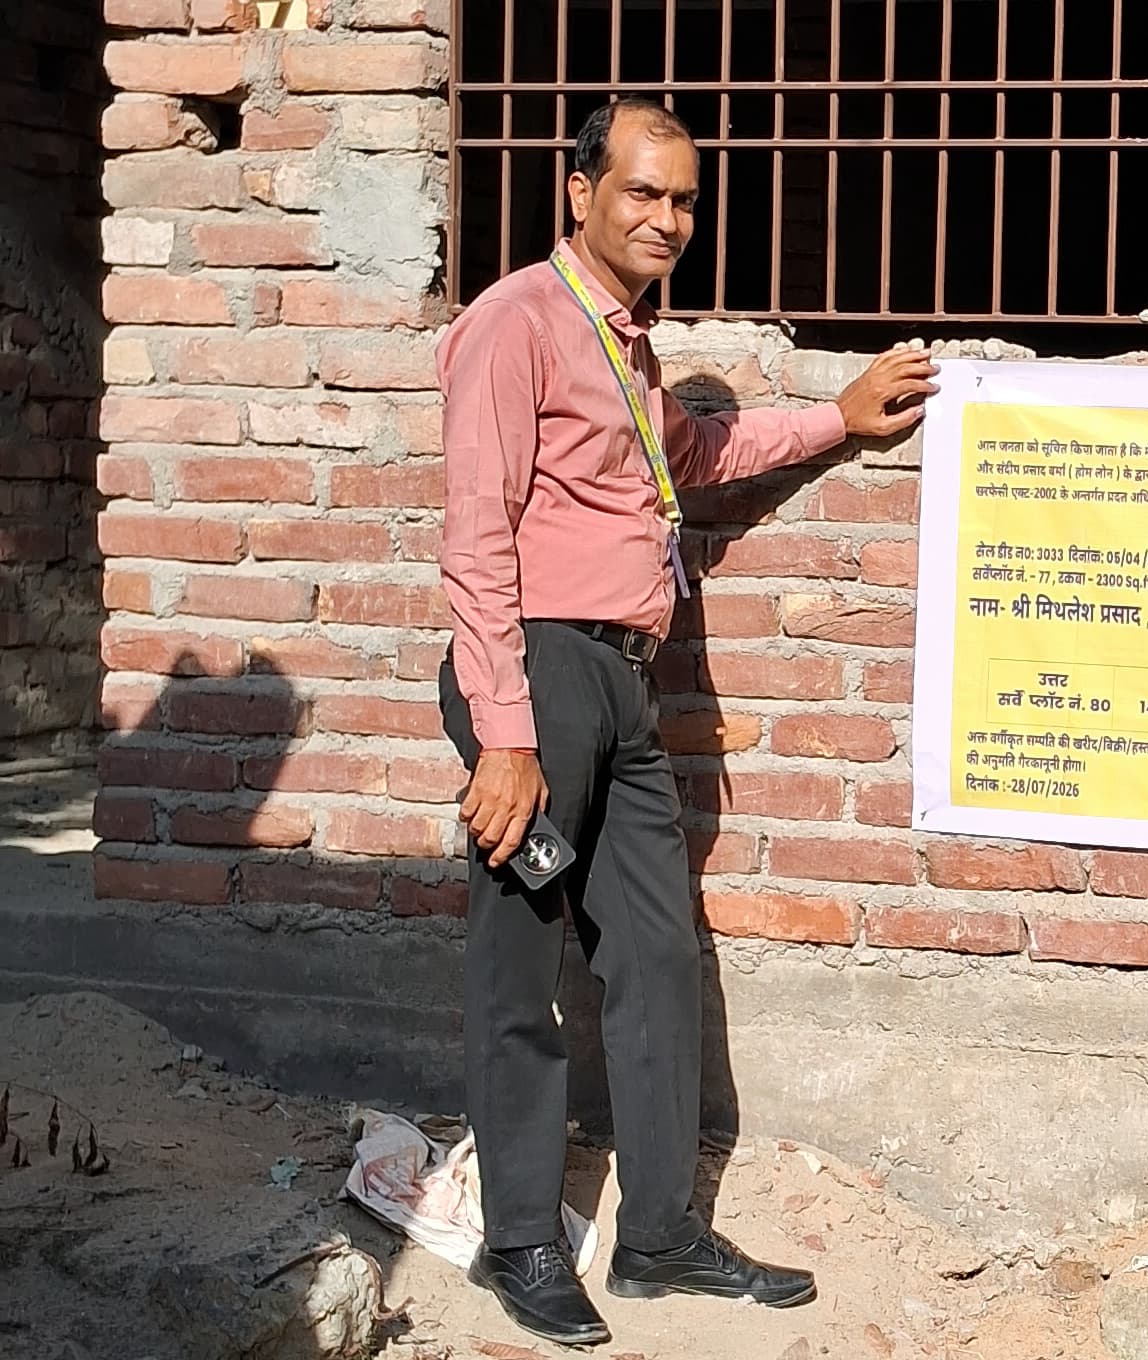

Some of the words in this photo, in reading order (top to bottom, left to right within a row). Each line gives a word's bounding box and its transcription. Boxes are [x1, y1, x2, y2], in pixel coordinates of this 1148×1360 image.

[999, 441, 1024, 452] जनता
[1027, 438, 1038, 453] को
[1042, 440, 1067, 457] सूचित
[1071, 440, 1092, 455] किया
[1096, 444, 1118, 456] जाता
[1120, 443, 1127, 458] है
[1130, 443, 1142, 456] कि
[977, 460, 994, 474] और
[1023, 465, 1046, 476] प्रसाद
[1049, 462, 1066, 476] वर्मा
[1123, 465, 1132, 479] के
[1060, 485, 1069, 500] के
[976, 541, 996, 558] सेल
[998, 541, 1013, 560] डीड
[1037, 548, 1064, 561] 3033
[1068, 545, 1104, 564] दिनांक:
[1096, 574, 1123, 588] 2300
[1012, 593, 1031, 619] श्री
[1035, 594, 1096, 622] मिथलेश
[997, 690, 1025, 706] सर्वे
[1029, 691, 1065, 709] प्लॉट
[1090, 699, 1111, 712] 80
[1058, 733, 1071, 749] की
[966, 750, 979, 765] की
[982, 752, 1015, 770] अनुमति
[1018, 753, 1060, 773] गैरकानूनी
[966, 773, 1000, 791] दिनांक
